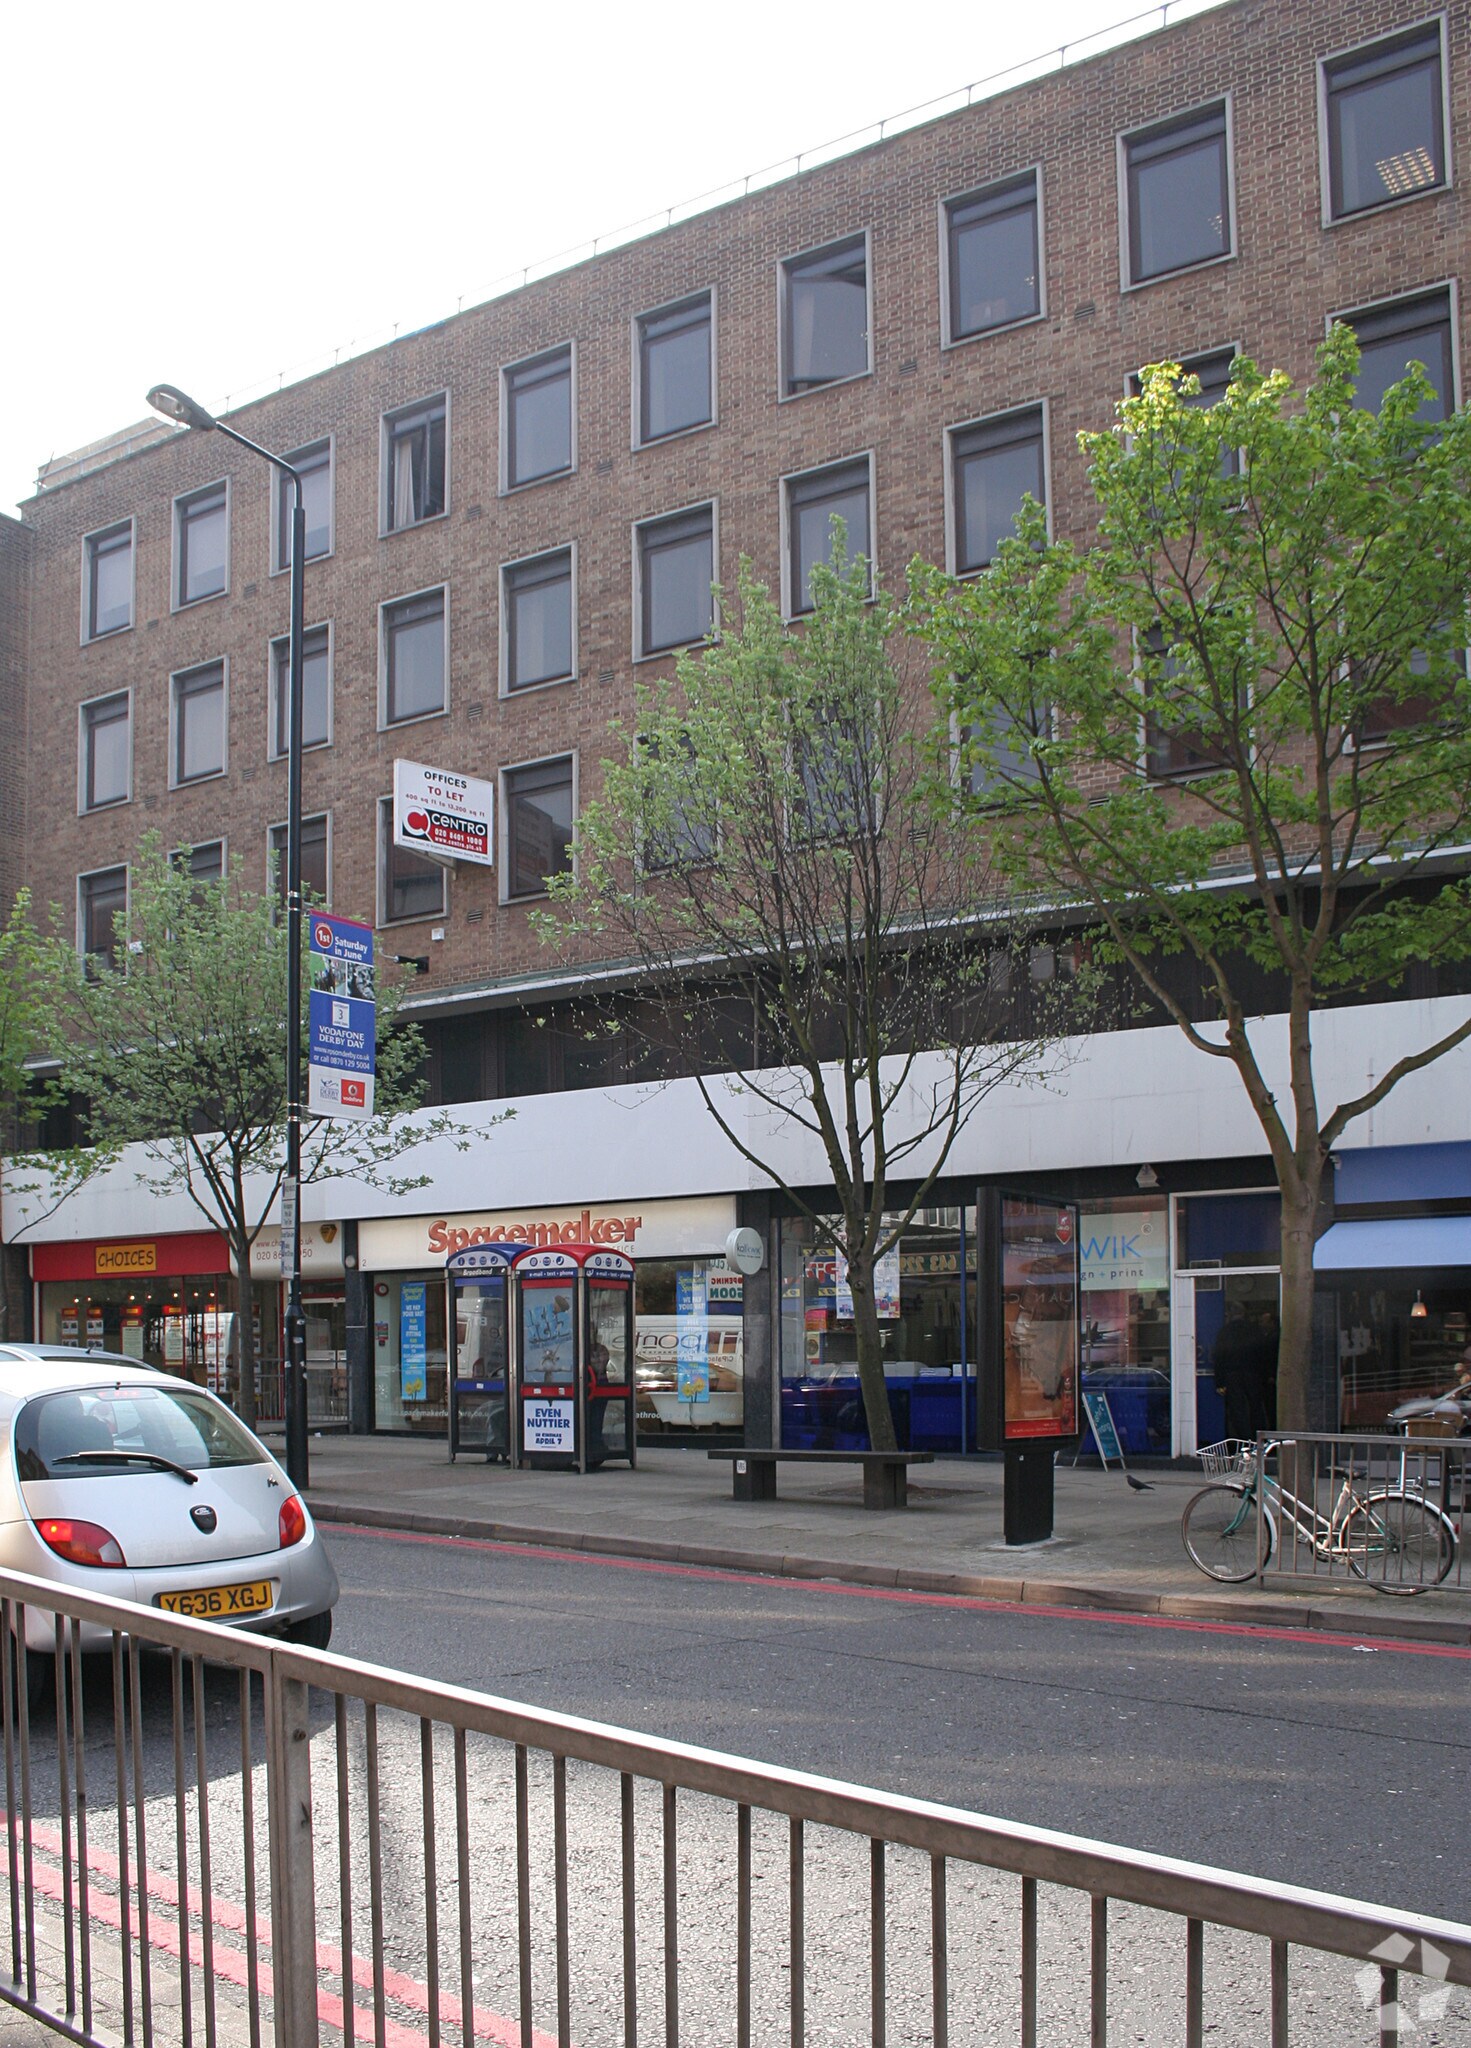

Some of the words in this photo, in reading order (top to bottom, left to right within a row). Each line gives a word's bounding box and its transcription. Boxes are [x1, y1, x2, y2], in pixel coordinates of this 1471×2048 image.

[424, 771, 467, 789] OFFICES
[428, 786, 441, 796] TO
[446, 790, 464, 802] LET
[435, 828, 447, 837] 020
[450, 832, 464, 842] 8401
[318, 930, 331, 943] 1st
[335, 936, 368, 954] Saturday
[335, 946, 342, 955] in
[344, 948, 362, 960] June
[338, 1009, 344, 1020] 3
[319, 1025, 364, 1041] VODAFONE
[319, 1033, 346, 1046] DERBY
[347, 1040, 364, 1049] DAY
[320, 1055, 330, 1064] call
[345, 1059, 355, 1068] 129
[428, 1210, 642, 1255] Spacemaker
[1081, 1234, 1142, 1260] WIK
[98, 1250, 154, 1267] CHOICES
[256, 1251, 271, 1260] 020
[361, 1259, 367, 1267] 2
[462, 1268, 493, 1276] Broadband
[1110, 1268, 1144, 1280] print
[535, 1408, 562, 1418] EVEN
[527, 1418, 570, 1428] NUTTIER
[165, 1592, 221, 1616] Y636
[227, 1585, 268, 1610] XGJ
